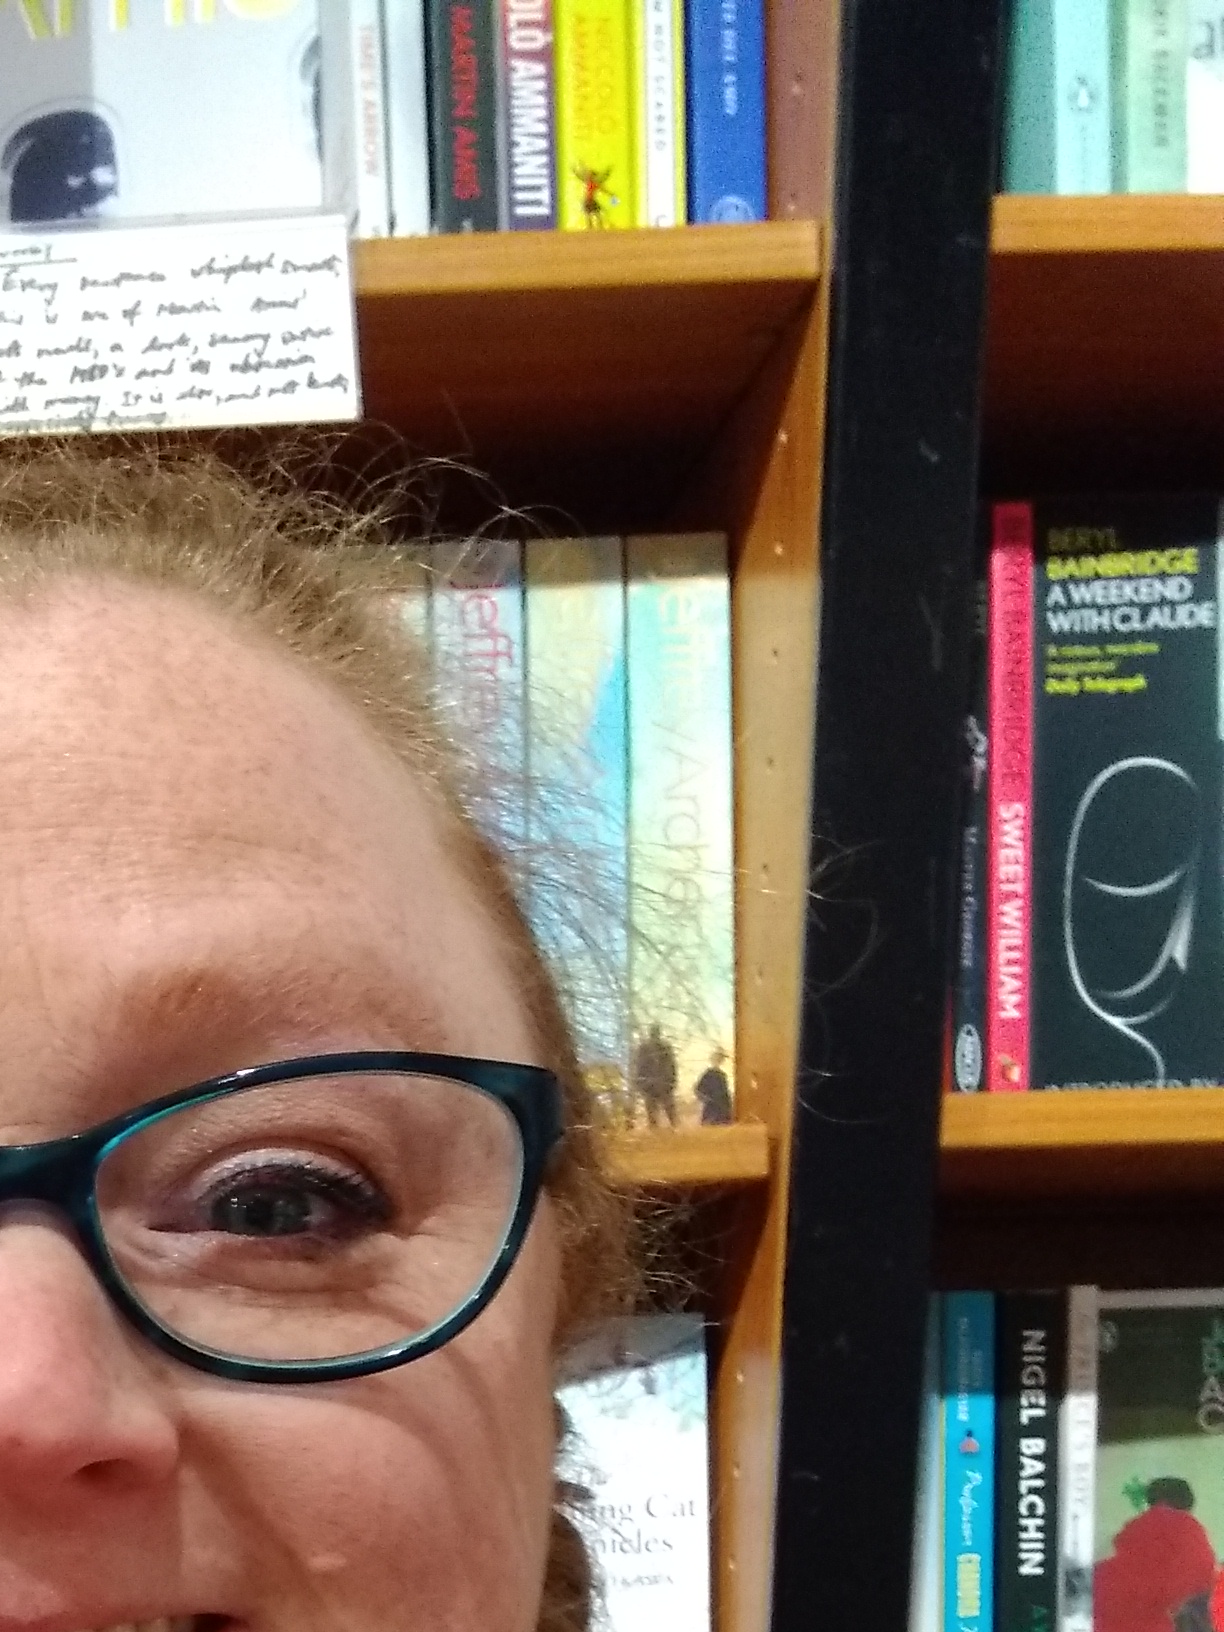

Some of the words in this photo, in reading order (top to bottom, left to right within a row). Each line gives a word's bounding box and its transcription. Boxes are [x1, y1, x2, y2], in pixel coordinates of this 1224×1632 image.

[450, 6, 477, 119] MARTIN
[653, 24, 667, 63] NOT
[363, 101, 379, 177] ARROW
[508, 58, 552, 217] AMMANITI
[653, 74, 668, 152] SCARED
[453, 126, 480, 200] AMIS
[110, 342, 124, 353] a
[122, 300, 142, 327] of
[1045, 547, 1199, 580] BAINBRIDGE
[1047, 581, 1067, 607] A
[1068, 576, 1194, 604] WEEKEND
[1046, 605, 1111, 634] WITH
[1110, 600, 1217, 632] CLAUDE
[998, 803, 1025, 894] SWEET
[997, 896, 1026, 1019] WILLIAM
[1019, 1328, 1045, 1427] NIGEL
[645, 1493, 696, 1518] Cat
[1018, 1436, 1046, 1578] BALCHIN
